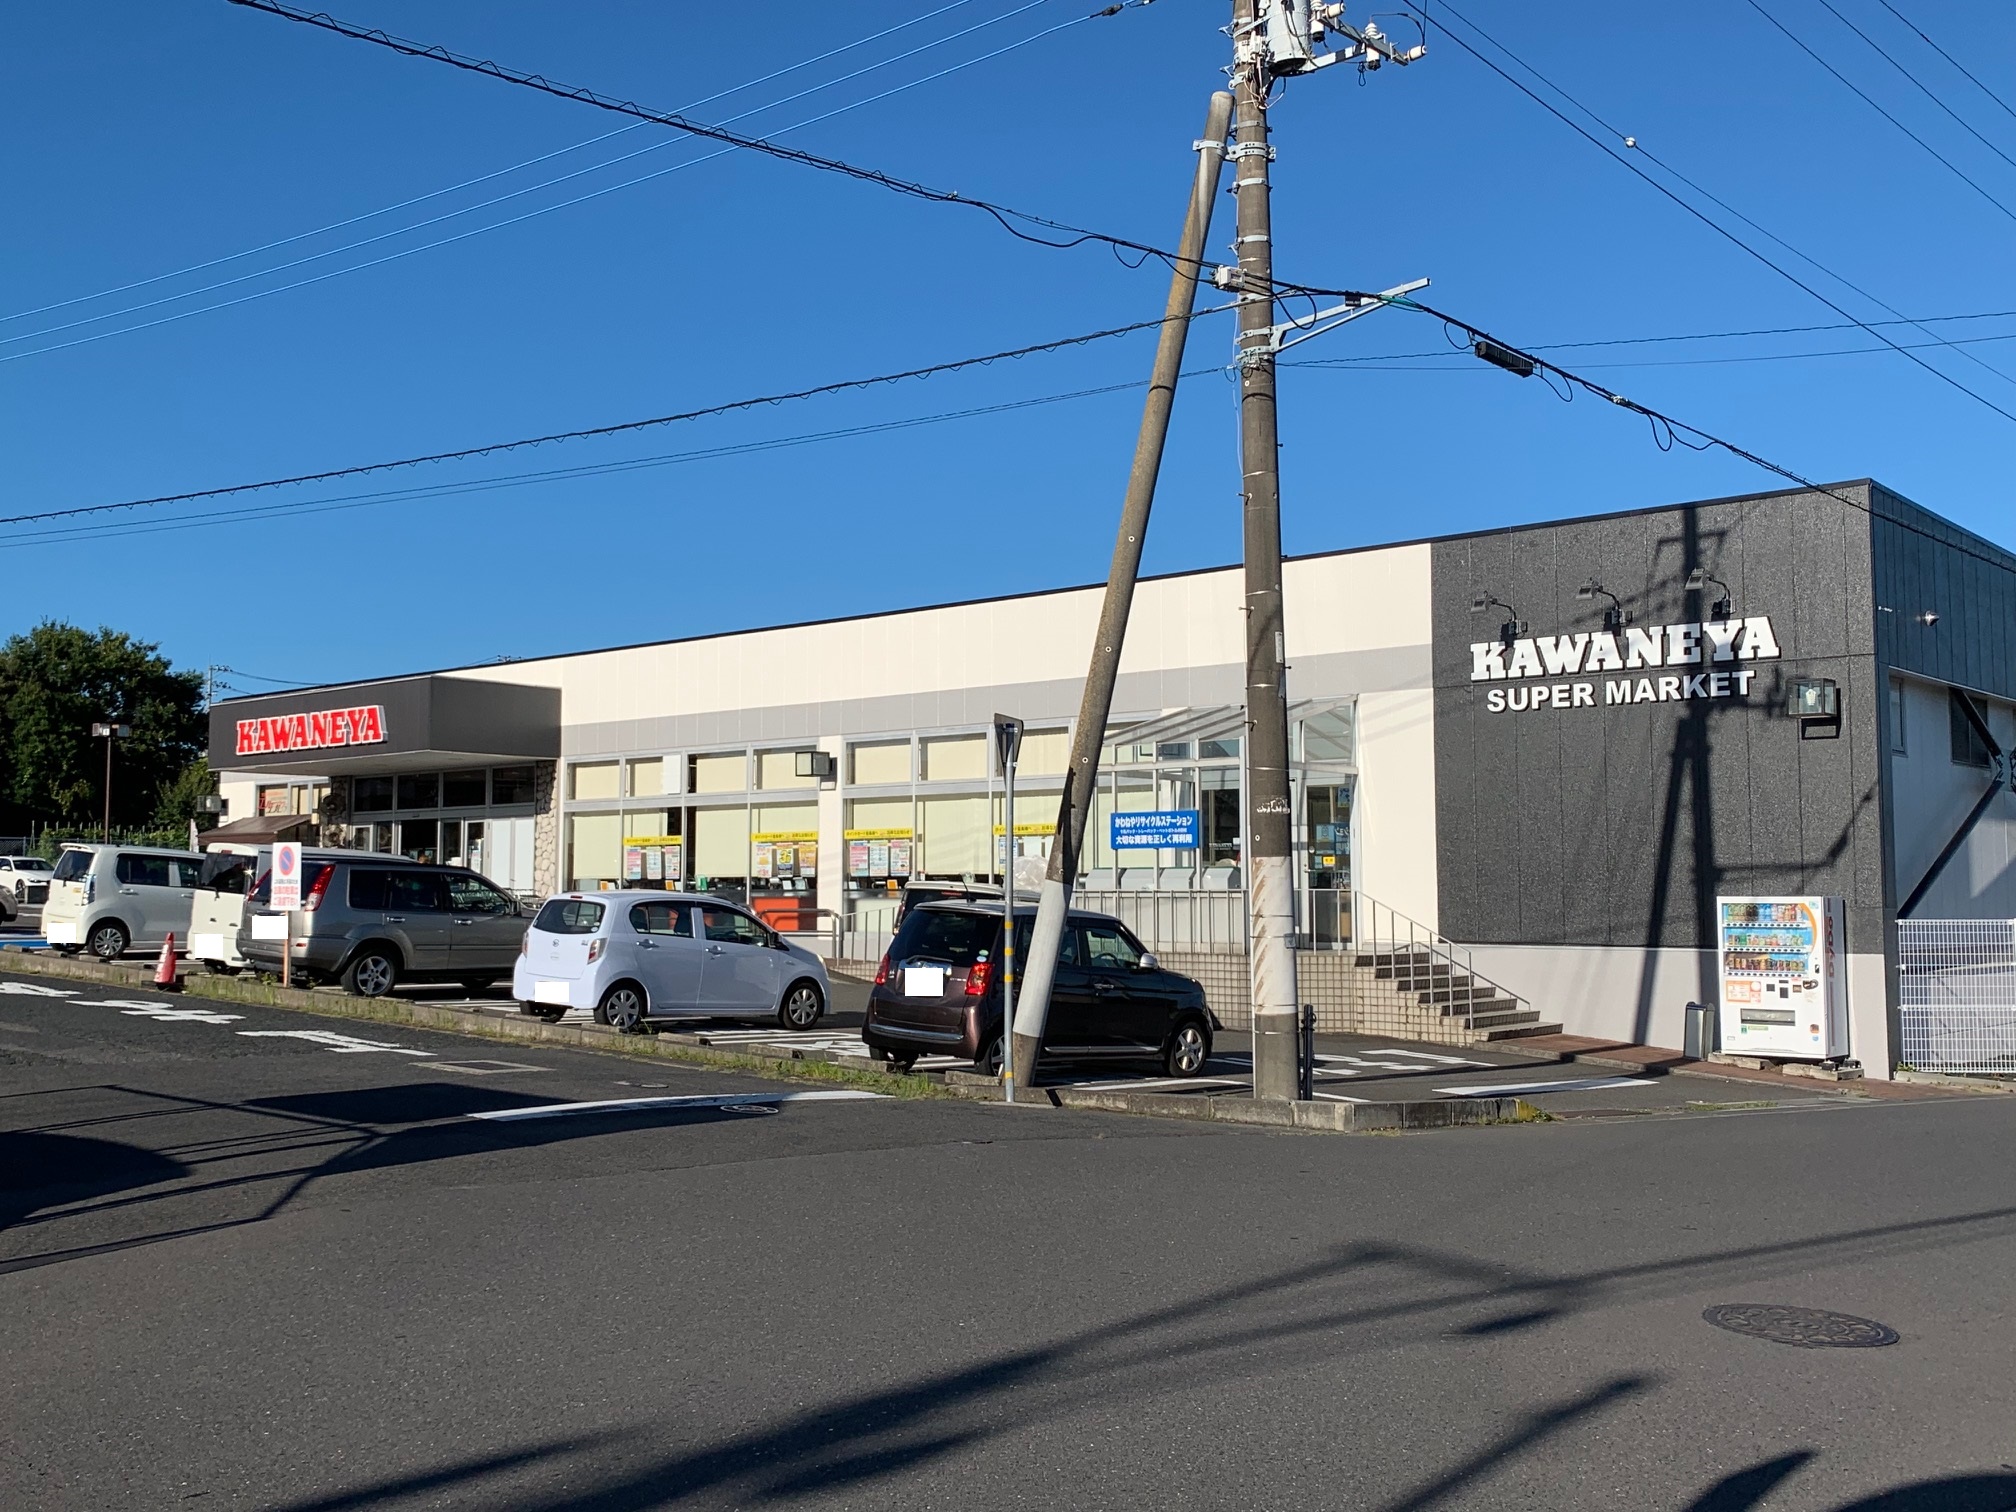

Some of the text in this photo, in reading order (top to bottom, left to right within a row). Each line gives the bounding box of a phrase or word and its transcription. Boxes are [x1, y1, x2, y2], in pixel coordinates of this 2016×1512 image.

[1470, 616, 1780, 681] KAWANEYA
[1487, 670, 1756, 713] SUPER MARKET
[235, 705, 384, 756] KAWANEYA
[1115, 833, 1193, 845] 大切な資源を正しく再利用
